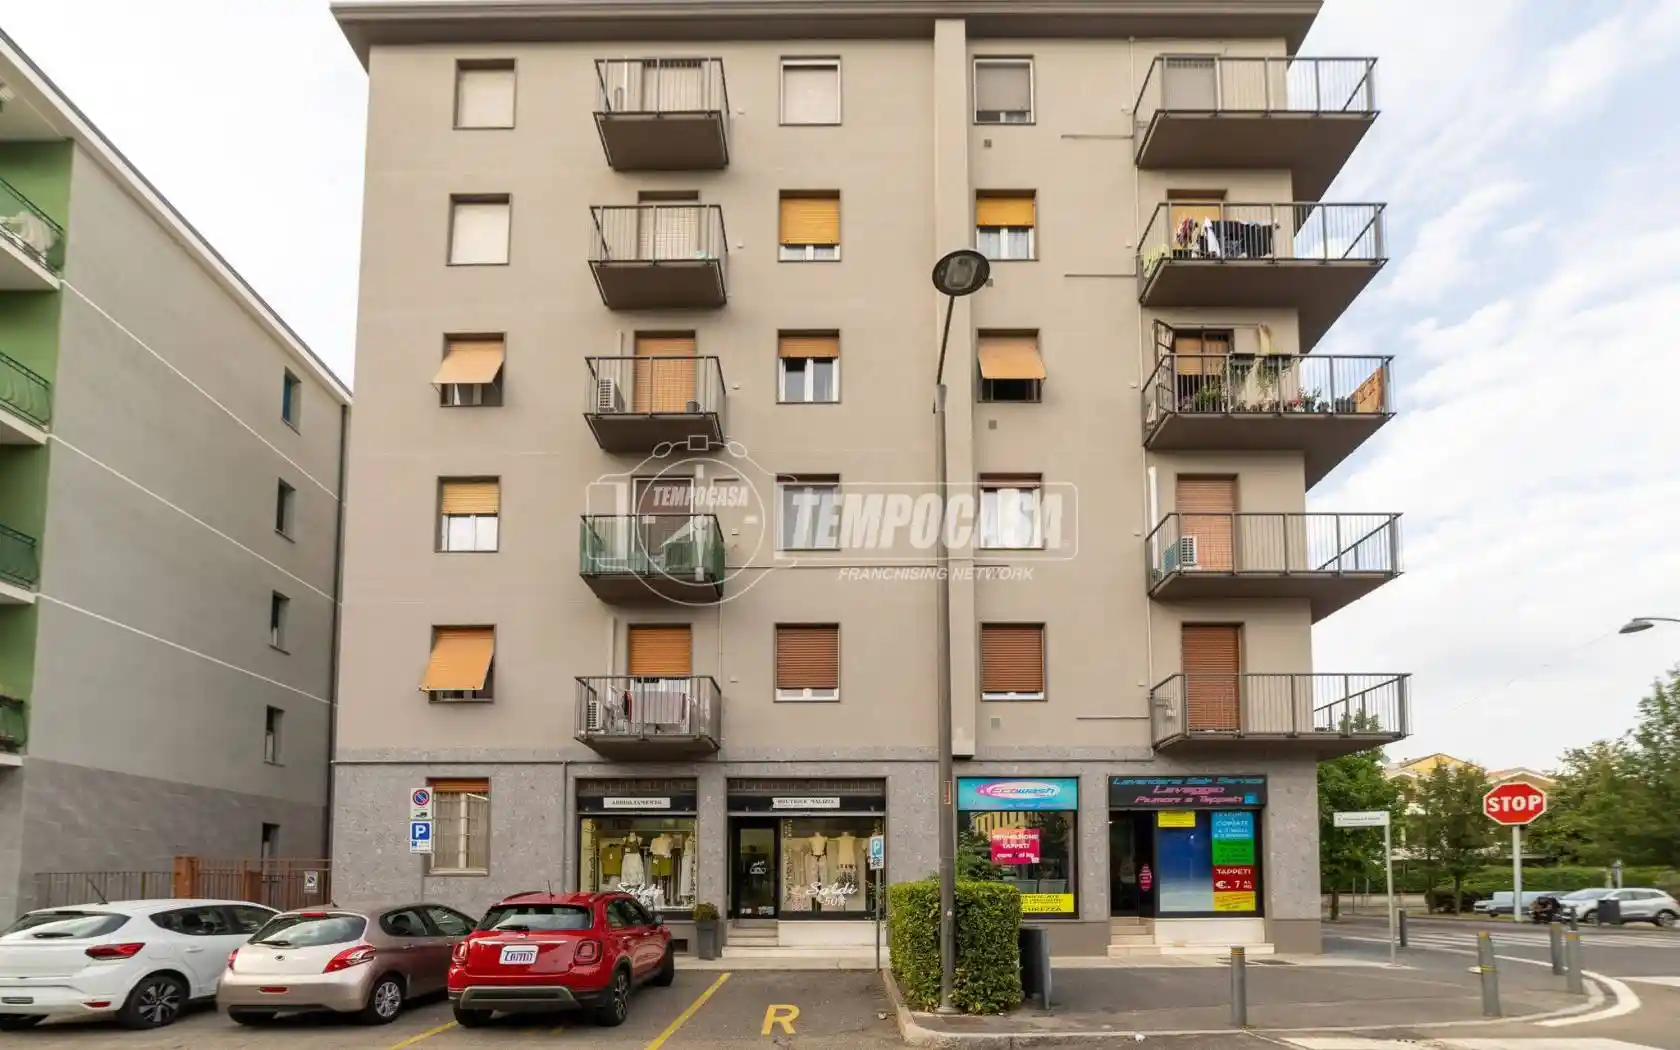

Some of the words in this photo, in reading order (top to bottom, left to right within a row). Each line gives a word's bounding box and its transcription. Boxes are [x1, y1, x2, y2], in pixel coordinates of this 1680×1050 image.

[1488, 794, 1542, 812] STOP
[415, 824, 427, 839] P
[872, 840, 882, 855] P
[761, 1004, 800, 1035] R
